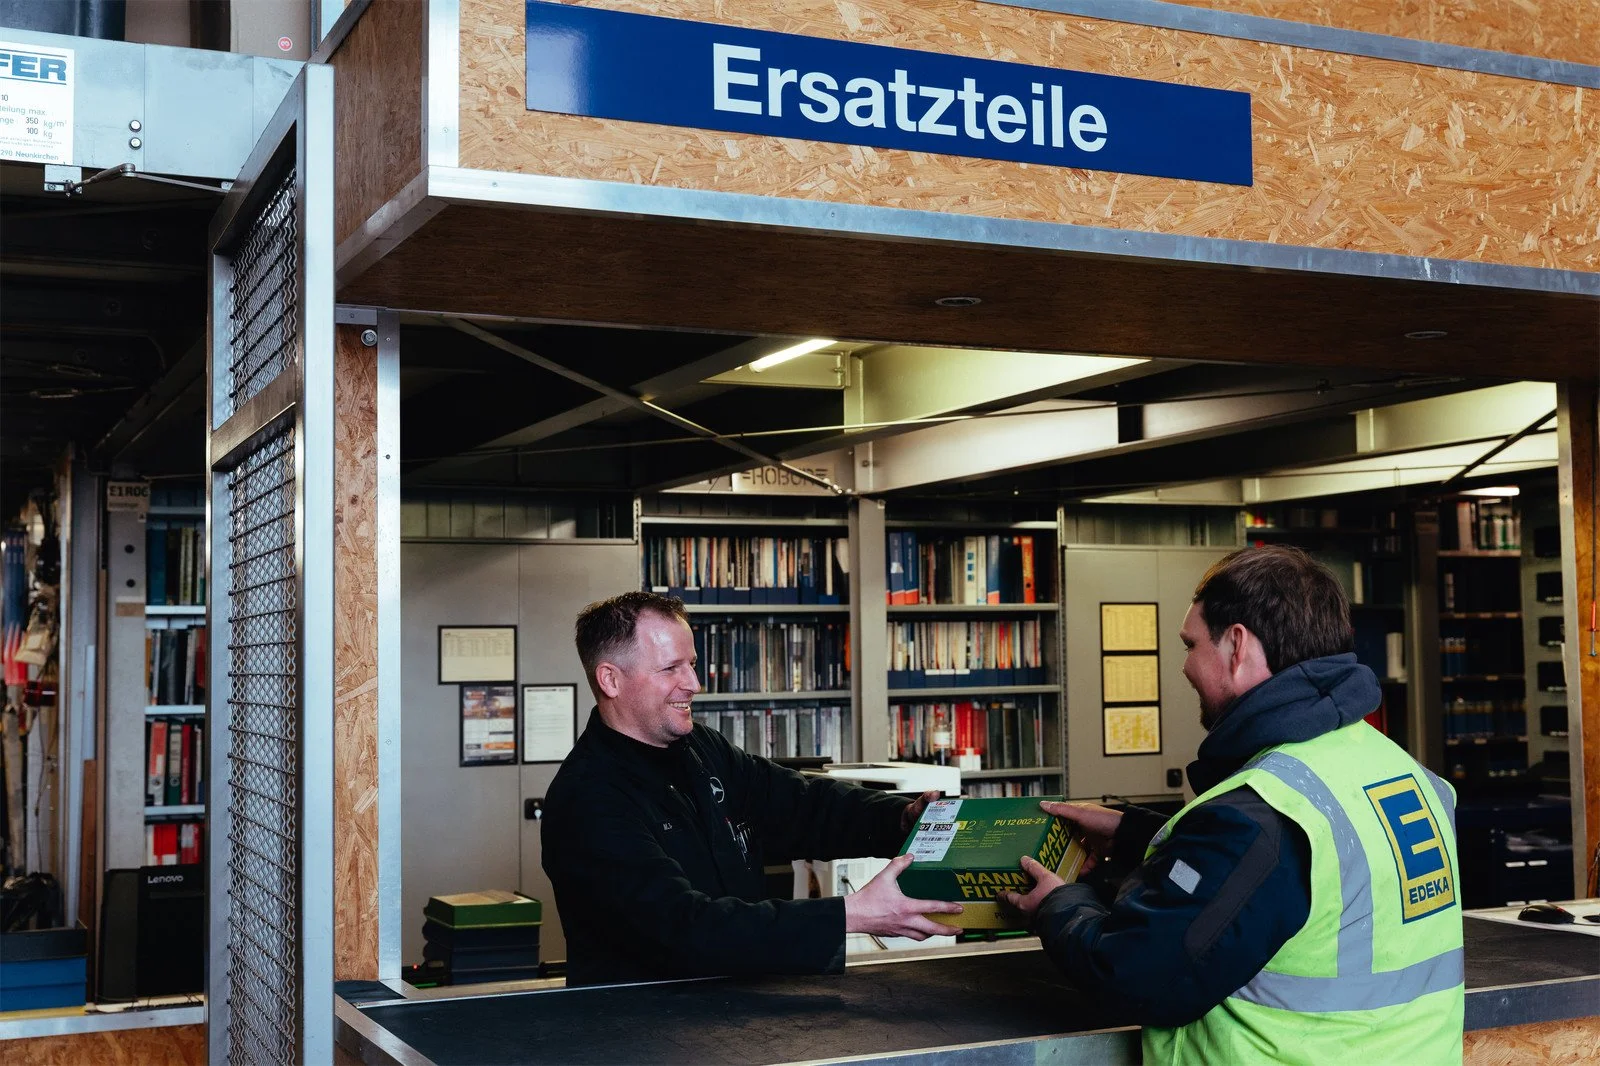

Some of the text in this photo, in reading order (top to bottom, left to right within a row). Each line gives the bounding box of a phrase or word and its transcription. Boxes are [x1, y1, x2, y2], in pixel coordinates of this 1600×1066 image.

[713, 43, 1108, 152] Ersatzteile
[25, 116, 39, 125] 350
[26, 127, 53, 139] 100 kg
[15, 150, 59, 161] Neunkirchen
[147, 875, 184, 884] Lenovo
[955, 872, 1028, 885] MANN
[1408, 876, 1450, 905] EDEKA
